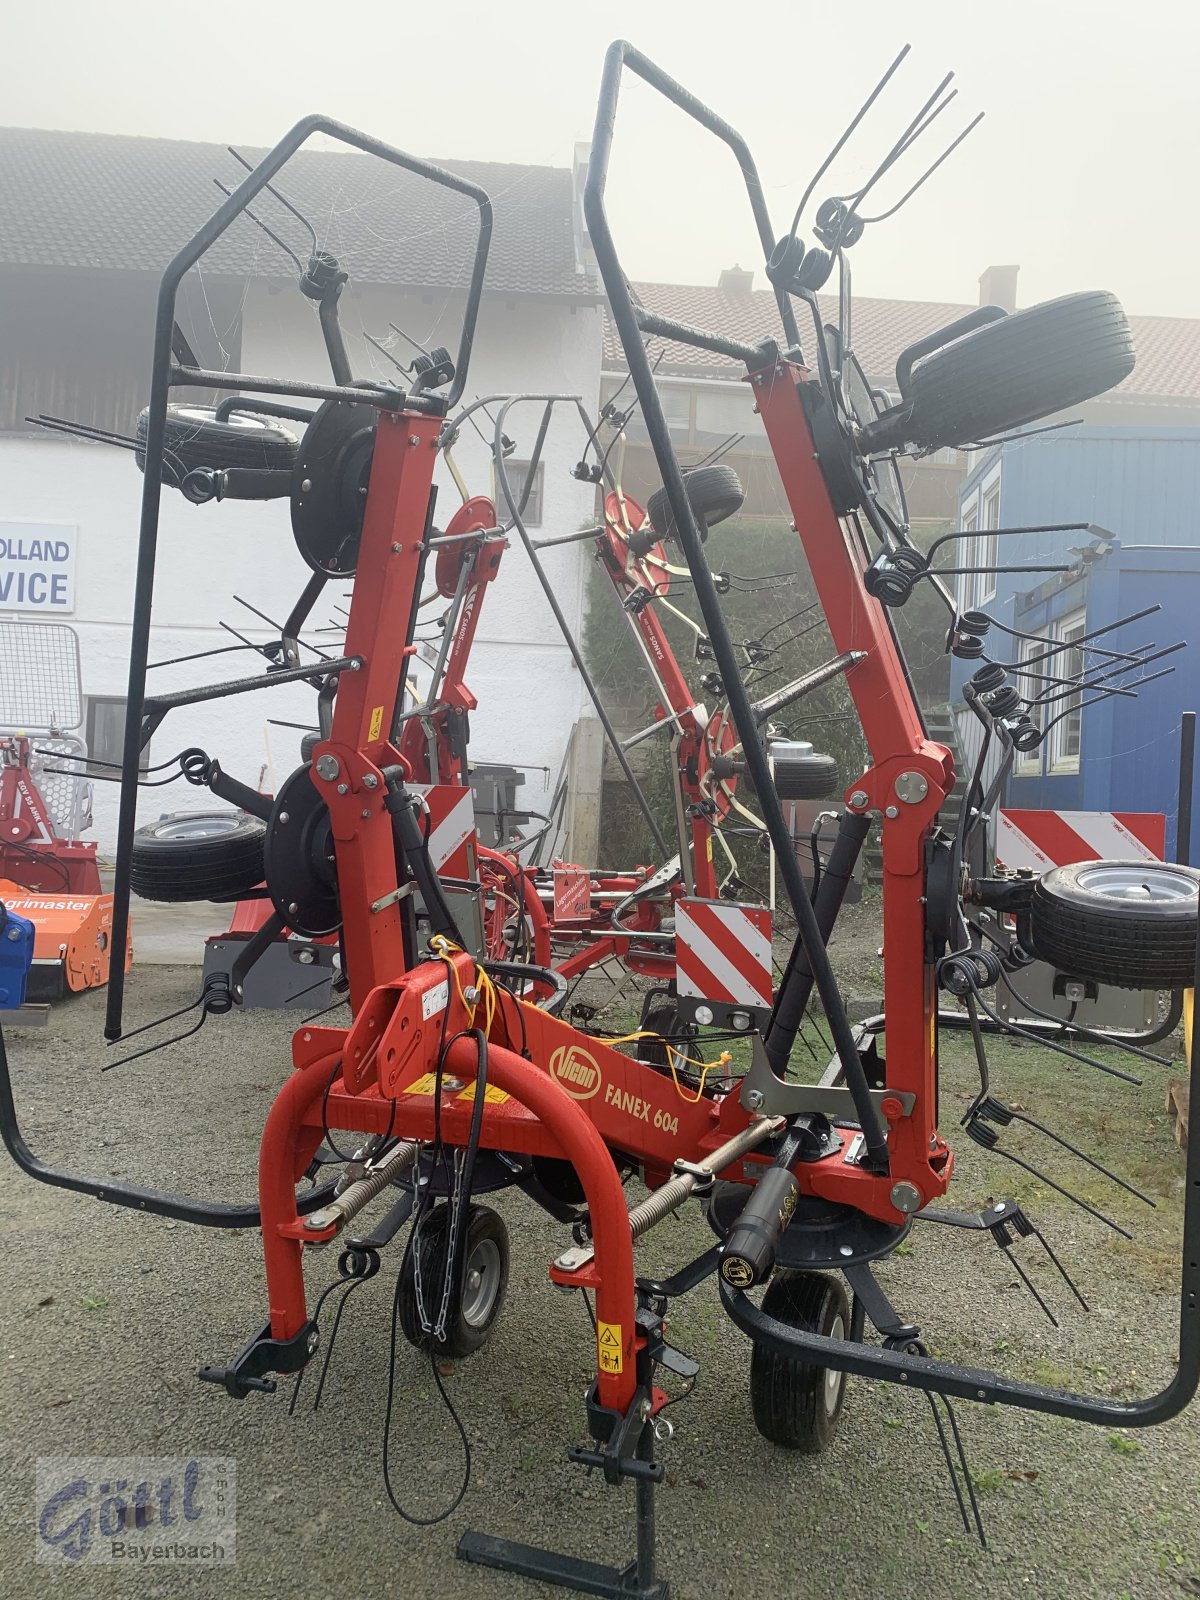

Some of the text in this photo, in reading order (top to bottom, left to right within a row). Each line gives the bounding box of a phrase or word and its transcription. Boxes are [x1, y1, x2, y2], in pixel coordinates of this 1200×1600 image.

[0, 572, 68, 604] VICE
[459, 617, 469, 641] SANOS
[650, 635, 664, 660] SANOS
[29, 806, 42, 823] AHK
[557, 1048, 597, 1089] Vicon
[604, 1083, 679, 1136] FANEX 604
